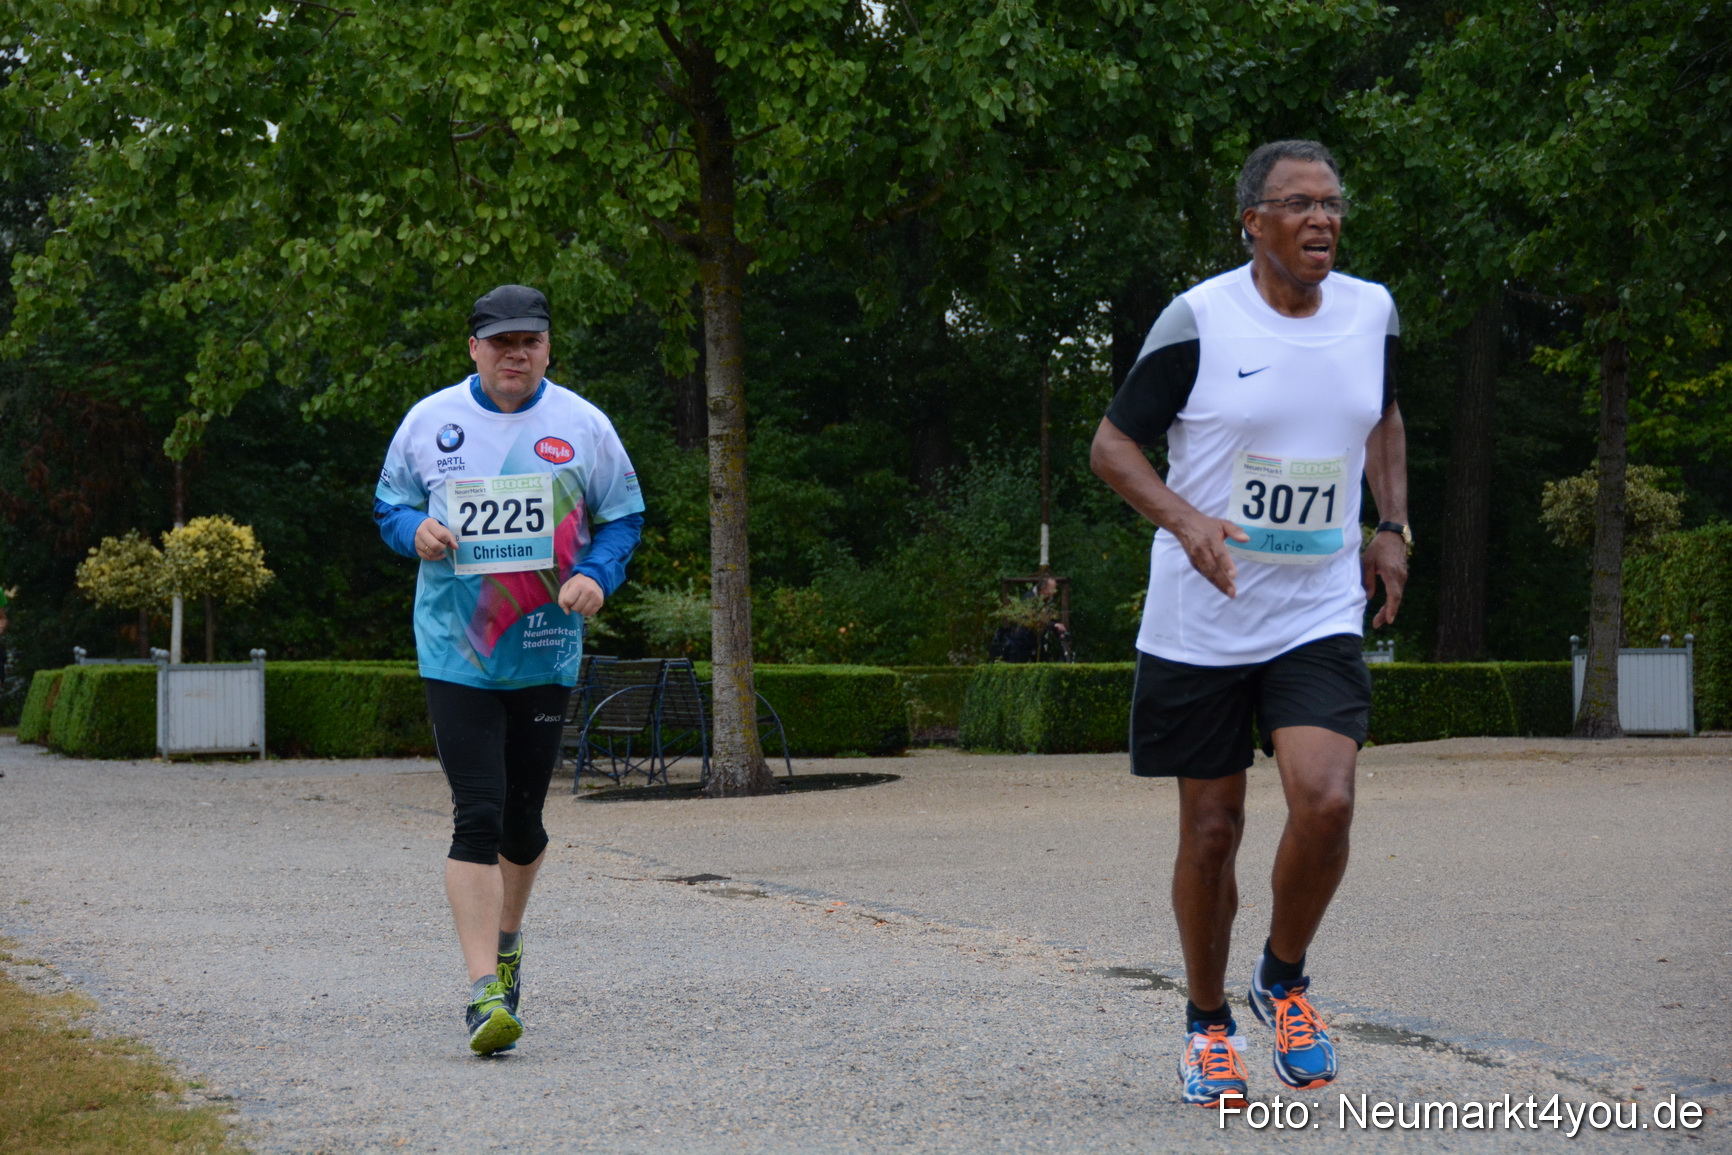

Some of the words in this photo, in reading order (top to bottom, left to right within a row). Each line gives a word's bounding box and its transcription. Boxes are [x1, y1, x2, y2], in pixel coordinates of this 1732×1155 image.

[540, 442, 570, 458] Hervis
[436, 456, 465, 468] PARTL
[1244, 463, 1283, 475] NeuerMarkt
[1290, 461, 1341, 474] BOCK
[492, 477, 544, 490] BOCK
[1242, 480, 1336, 524] 3071
[458, 497, 544, 537] 2225
[1260, 534, 1304, 552] Mario
[473, 544, 533, 560] Christian
[527, 612, 548, 628] 17.
[522, 638, 566, 649] Stadtlauf
